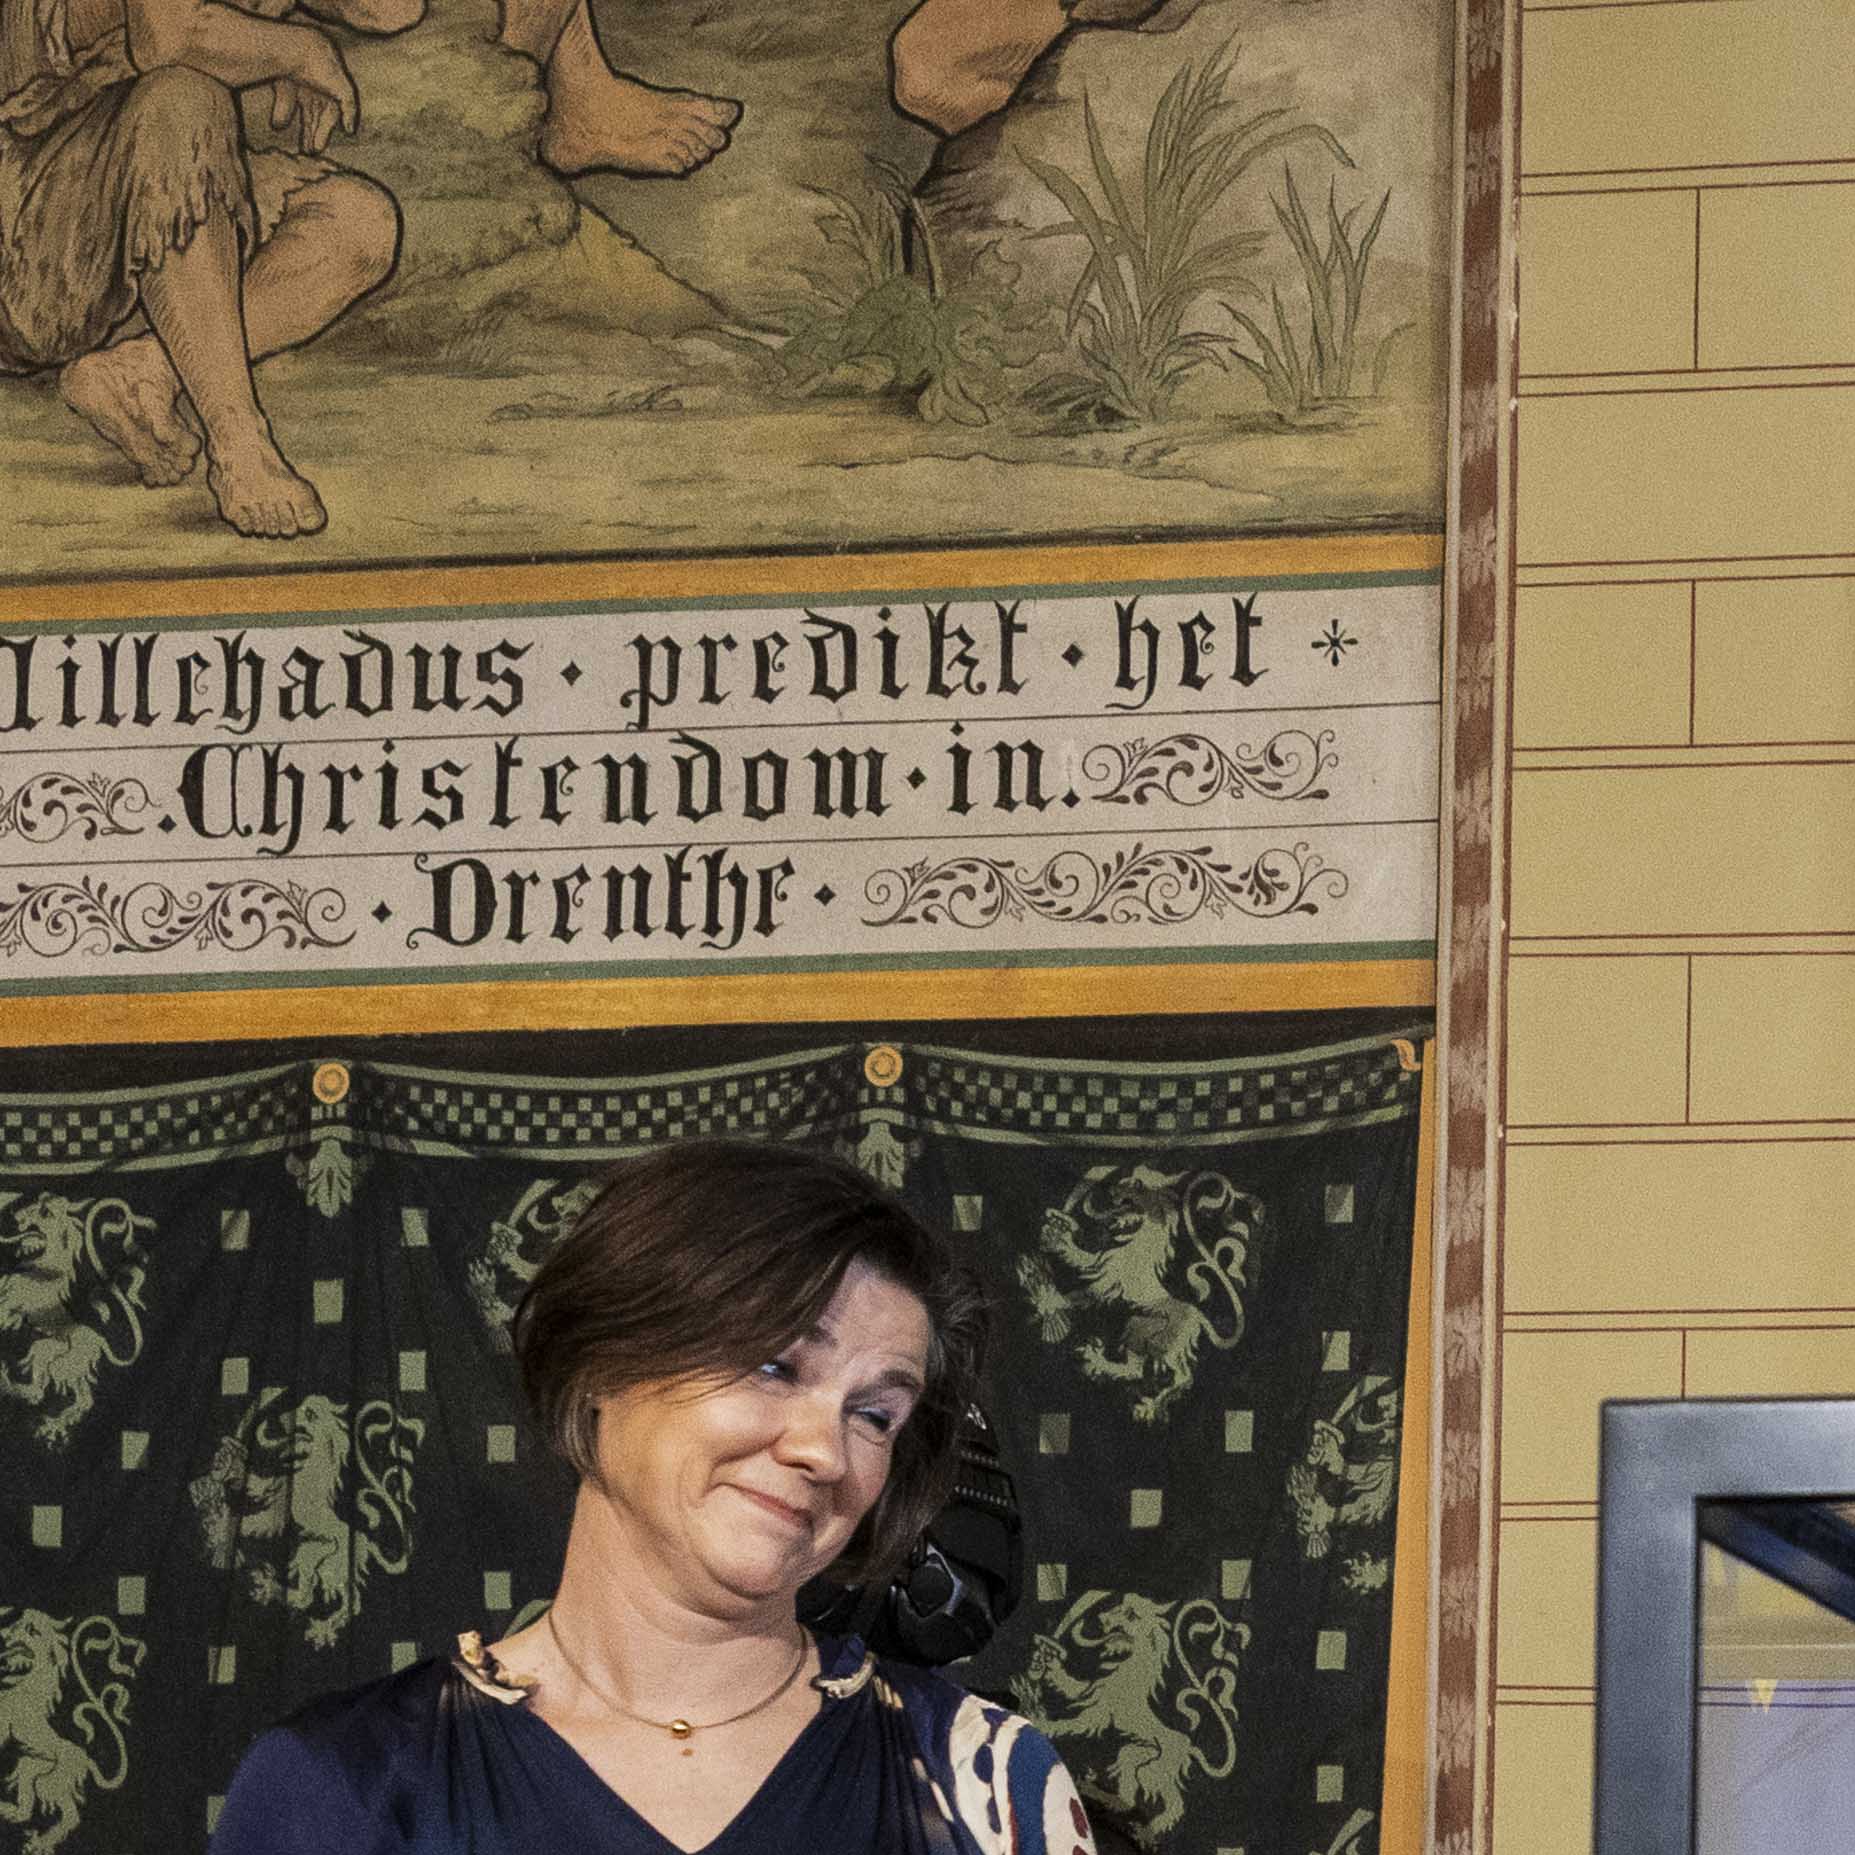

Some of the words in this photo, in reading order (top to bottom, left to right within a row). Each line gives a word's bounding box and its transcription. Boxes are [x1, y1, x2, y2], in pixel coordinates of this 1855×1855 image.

[620, 600, 1028, 730] predikt
[1104, 593, 1269, 710] het
[177, 731, 890, 858] Christendom
[406, 843, 795, 951] Drenthe
